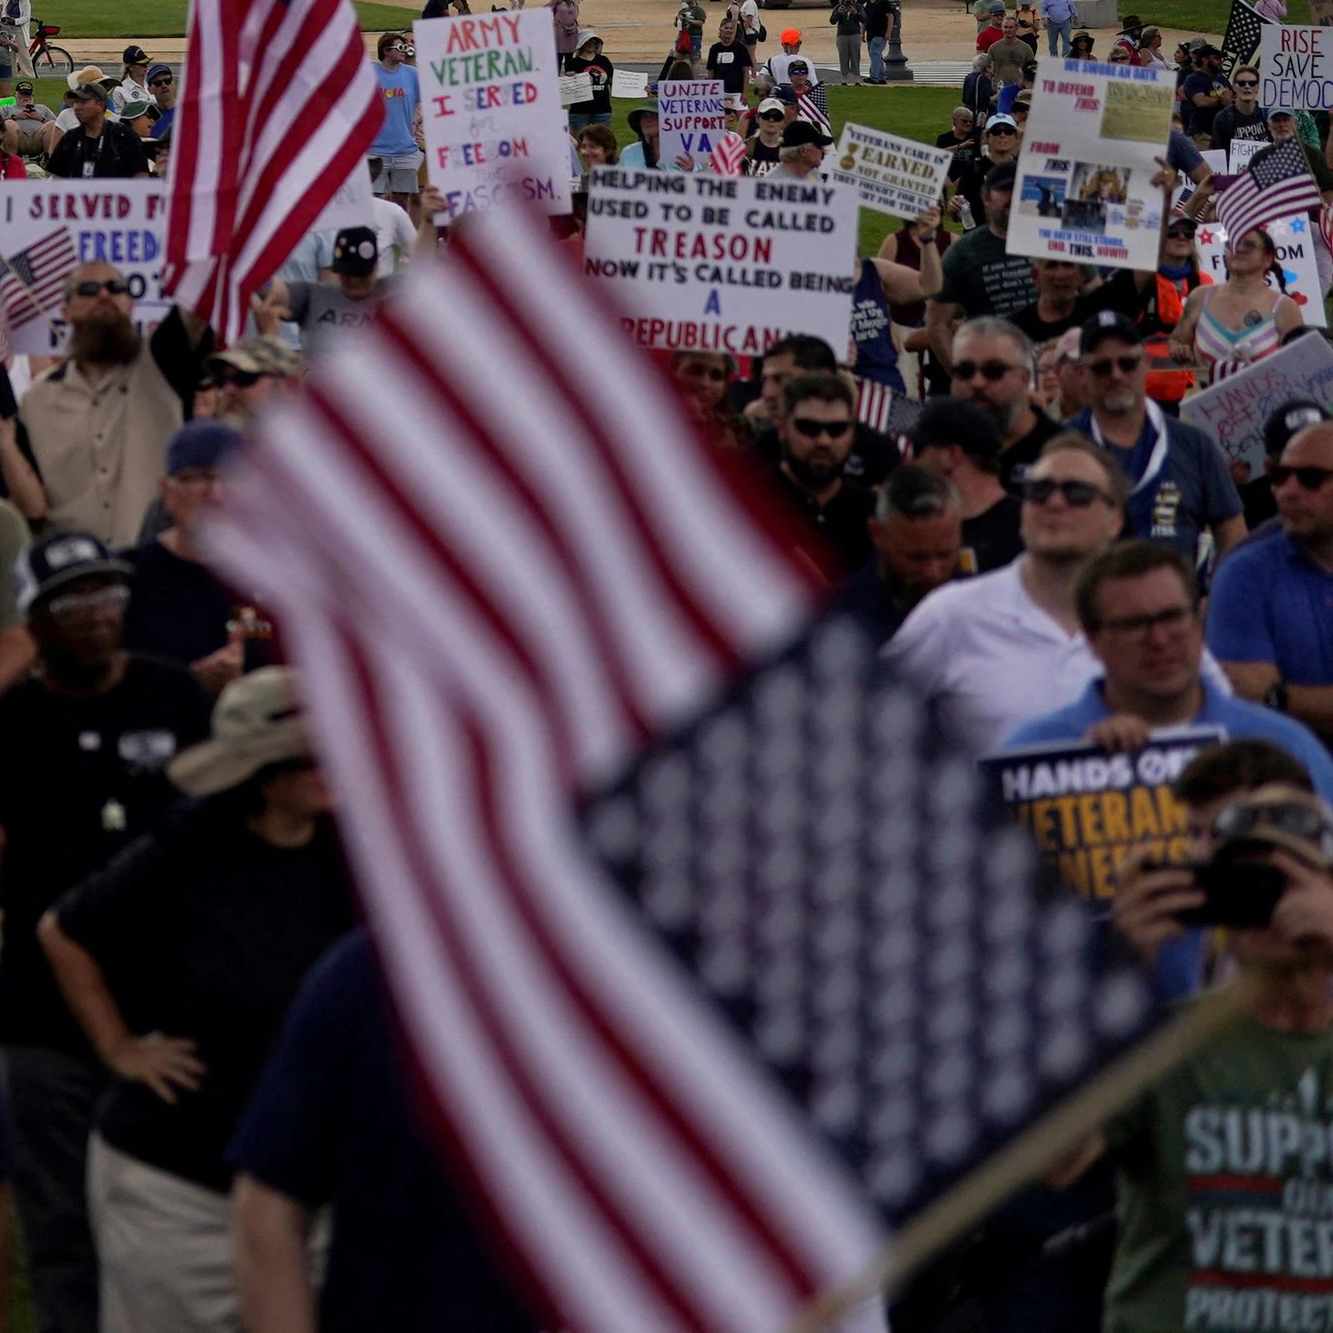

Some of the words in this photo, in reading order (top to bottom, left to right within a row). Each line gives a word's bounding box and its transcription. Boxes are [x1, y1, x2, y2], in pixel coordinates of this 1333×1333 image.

[446, 15, 522, 54] ARMY
[1281, 29, 1324, 54] RISE
[431, 46, 541, 86] VETERAN.
[1271, 53, 1325, 79] SAVE
[432, 95, 455, 118] I
[463, 81, 538, 112] SERVED
[664, 82, 720, 98] UNITE
[1042, 80, 1055, 93] TO
[1056, 81, 1095, 96] DEFEND
[1262, 79, 1333, 109] DEMOC
[660, 98, 725, 114] VETERANS
[661, 116, 725, 131] SUPPORT
[680, 133, 713, 152] VA
[850, 129, 902, 152] VETERANS
[904, 147, 932, 162] CARE
[934, 156, 944, 165] IS
[1030, 141, 1061, 155] FROM
[857, 166, 879, 179] NOT
[861, 147, 935, 179] EARNED
[446, 177, 561, 217] FASCSM.
[591, 169, 686, 194] HELPING
[695, 177, 738, 199] THE
[756, 182, 835, 206] ENEMY
[833, 172, 857, 185] THEY
[897, 191, 915, 202] FOR
[6, 196, 13, 223] I
[29, 193, 131, 220] SERVED
[590, 198, 649, 218] USED
[660, 203, 692, 222] TO
[702, 207, 730, 226] BE
[745, 210, 835, 233] CALLED
[78, 230, 160, 263] FREED
[633, 227, 773, 264] TREASON
[586, 258, 639, 278] NOW
[647, 262, 687, 284] IT'S
[695, 264, 782, 288] CALLED
[789, 271, 854, 294] BEING
[704, 288, 722, 315] A
[1002, 754, 1133, 802] HANDS
[1137, 746, 1197, 785] OF
[1185, 1103, 1333, 1178] SUPP
